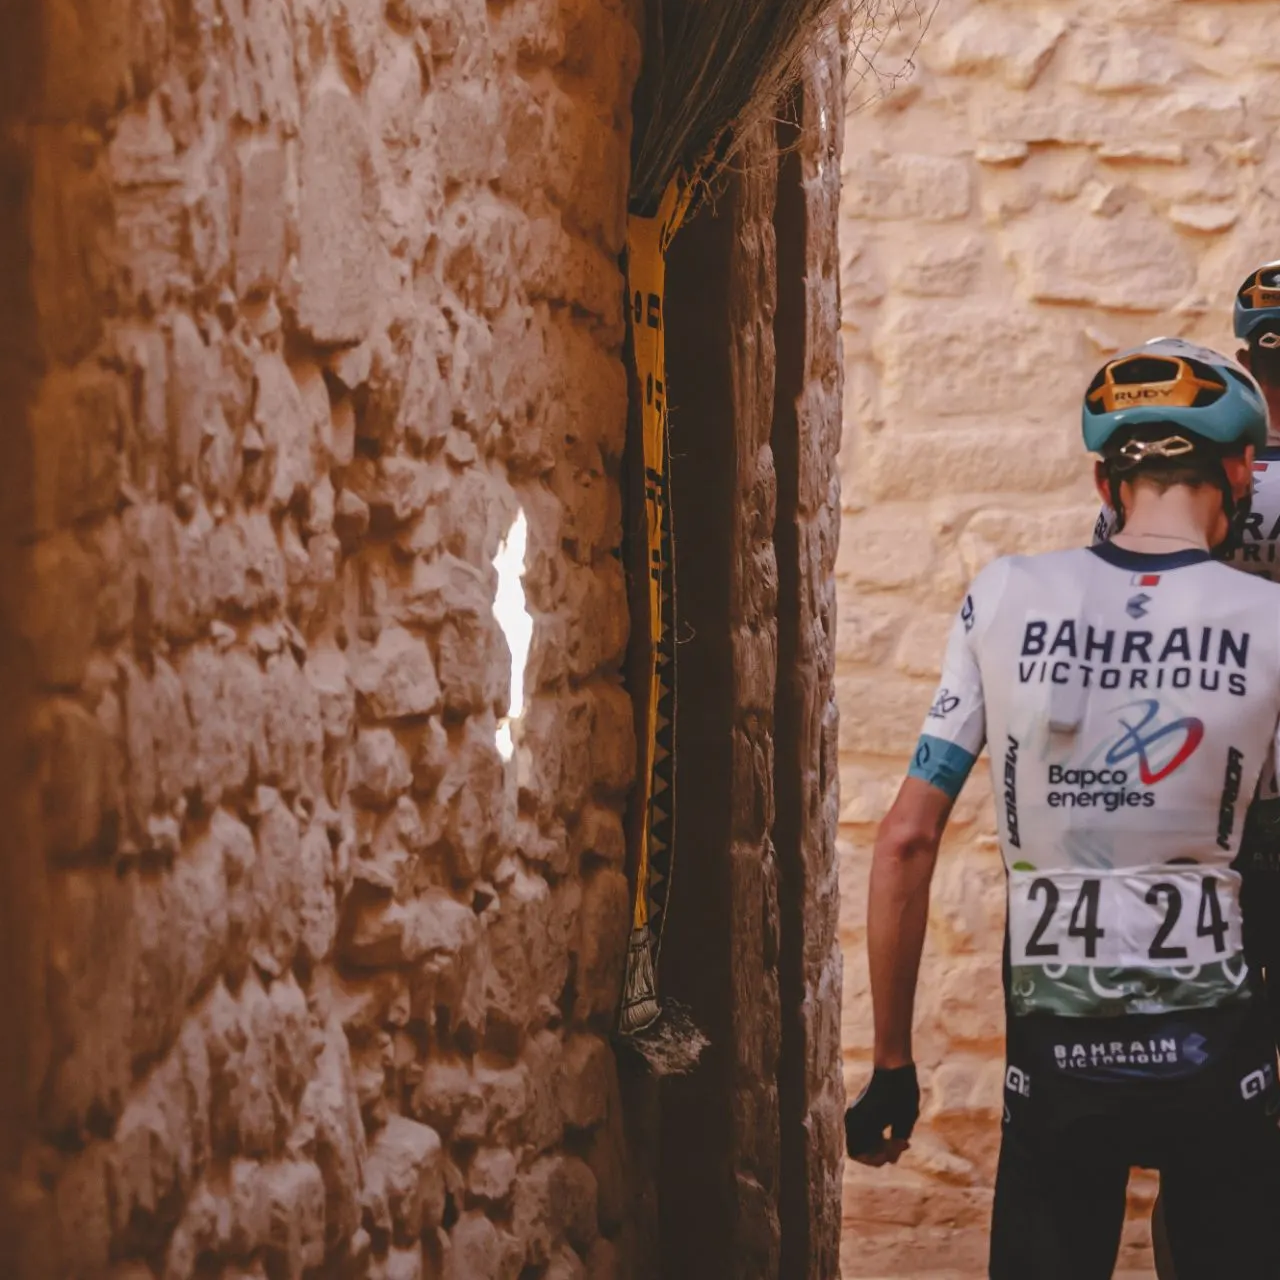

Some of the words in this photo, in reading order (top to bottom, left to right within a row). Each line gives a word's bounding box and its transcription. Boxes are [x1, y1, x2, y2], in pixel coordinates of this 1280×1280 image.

[1113, 388, 1175, 403] RUDY
[1021, 620, 1250, 669] BAHRAIN
[1019, 660, 1246, 696] VICTORIOUS
[1048, 764, 1127, 787] Bapco
[1003, 735, 1021, 850] MERIDA
[1047, 787, 1155, 812] energies
[1025, 878, 1104, 959] 24
[1145, 877, 1229, 960] 24
[1053, 1037, 1177, 1059] BAHRAIN
